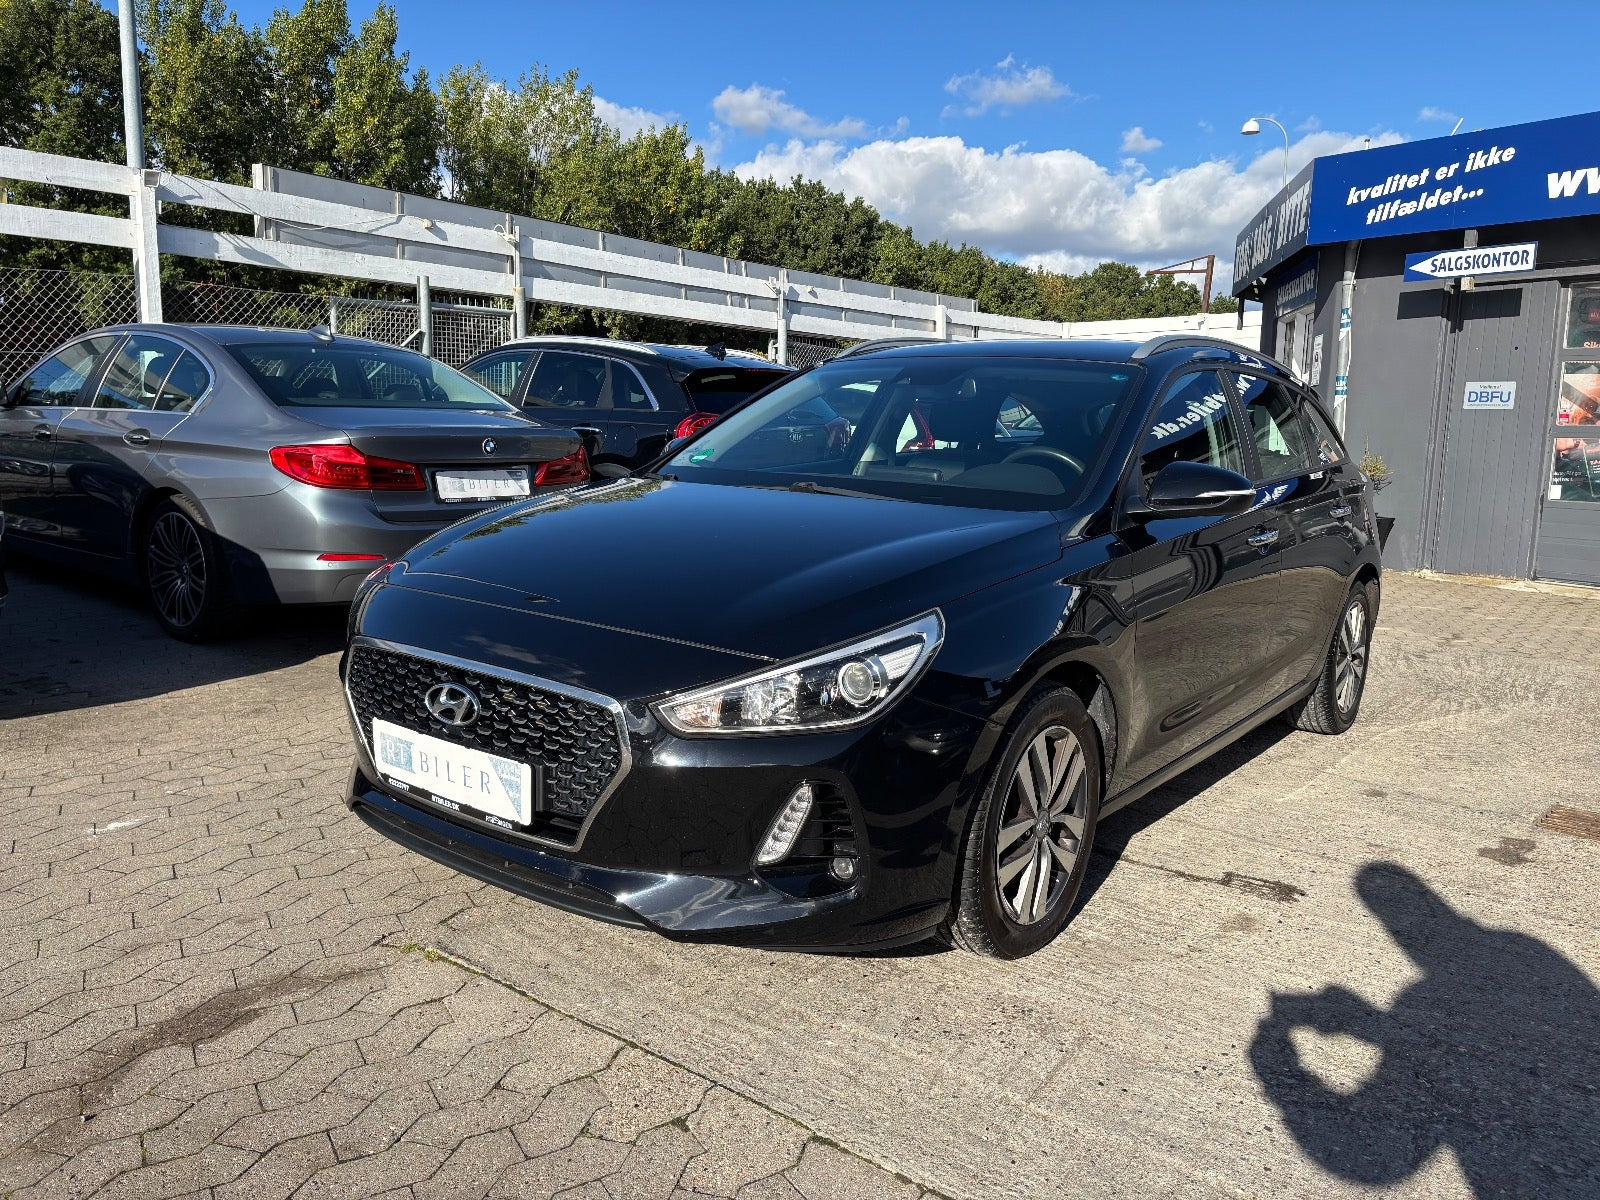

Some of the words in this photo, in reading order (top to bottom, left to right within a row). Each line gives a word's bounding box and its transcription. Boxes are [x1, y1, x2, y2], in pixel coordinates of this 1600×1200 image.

[1346, 168, 1430, 206] kvalitet
[1435, 162, 1460, 181] er
[1464, 146, 1516, 173] ikke
[1366, 185, 1484, 225] tilfældet...
[1430, 249, 1530, 273] SALGSKONTOR
[1467, 391, 1511, 403] DBFU
[419, 750, 491, 794] BILER
